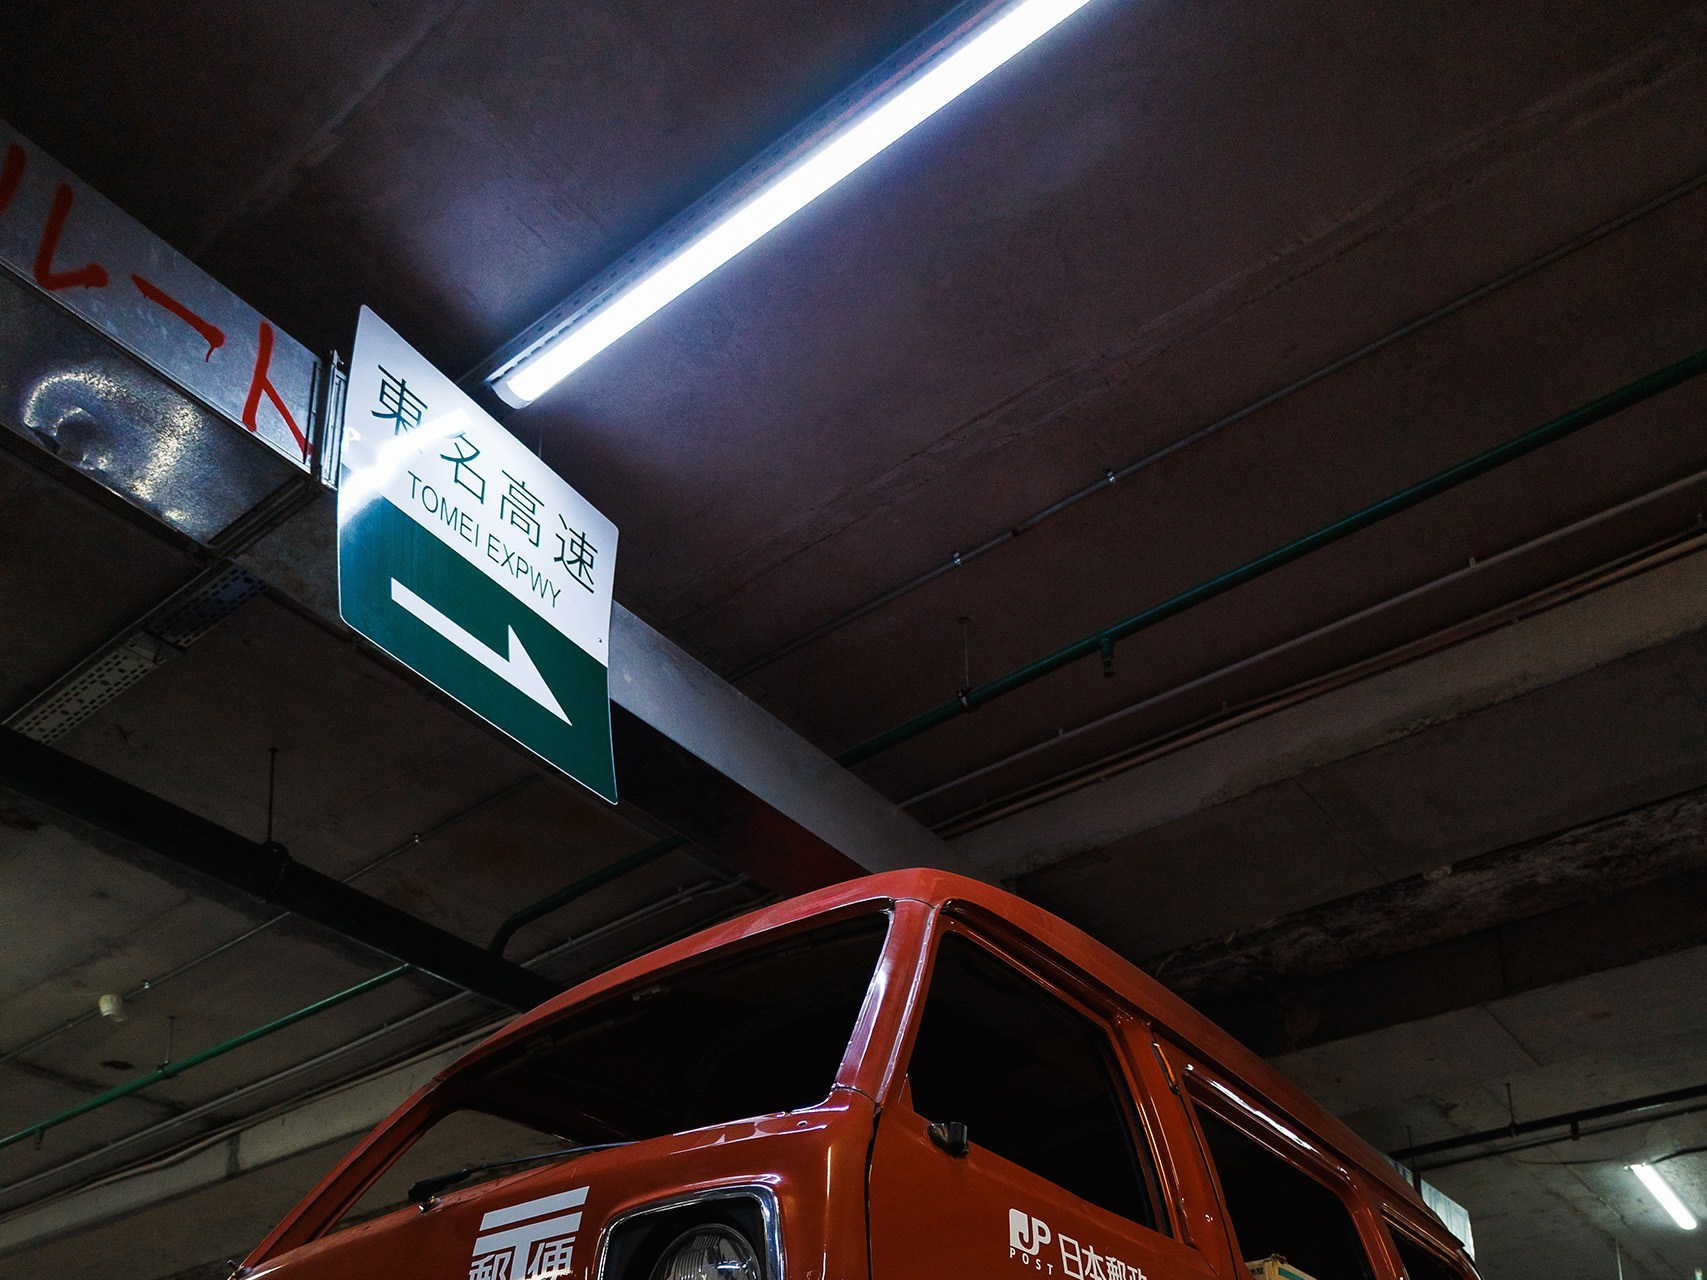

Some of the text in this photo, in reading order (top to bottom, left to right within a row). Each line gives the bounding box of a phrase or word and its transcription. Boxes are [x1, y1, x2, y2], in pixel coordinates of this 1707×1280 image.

[370, 364, 599, 595] 東名高速
[407, 469, 562, 609] TOMEI EXPWY
[1009, 1246, 1055, 1277] POST
